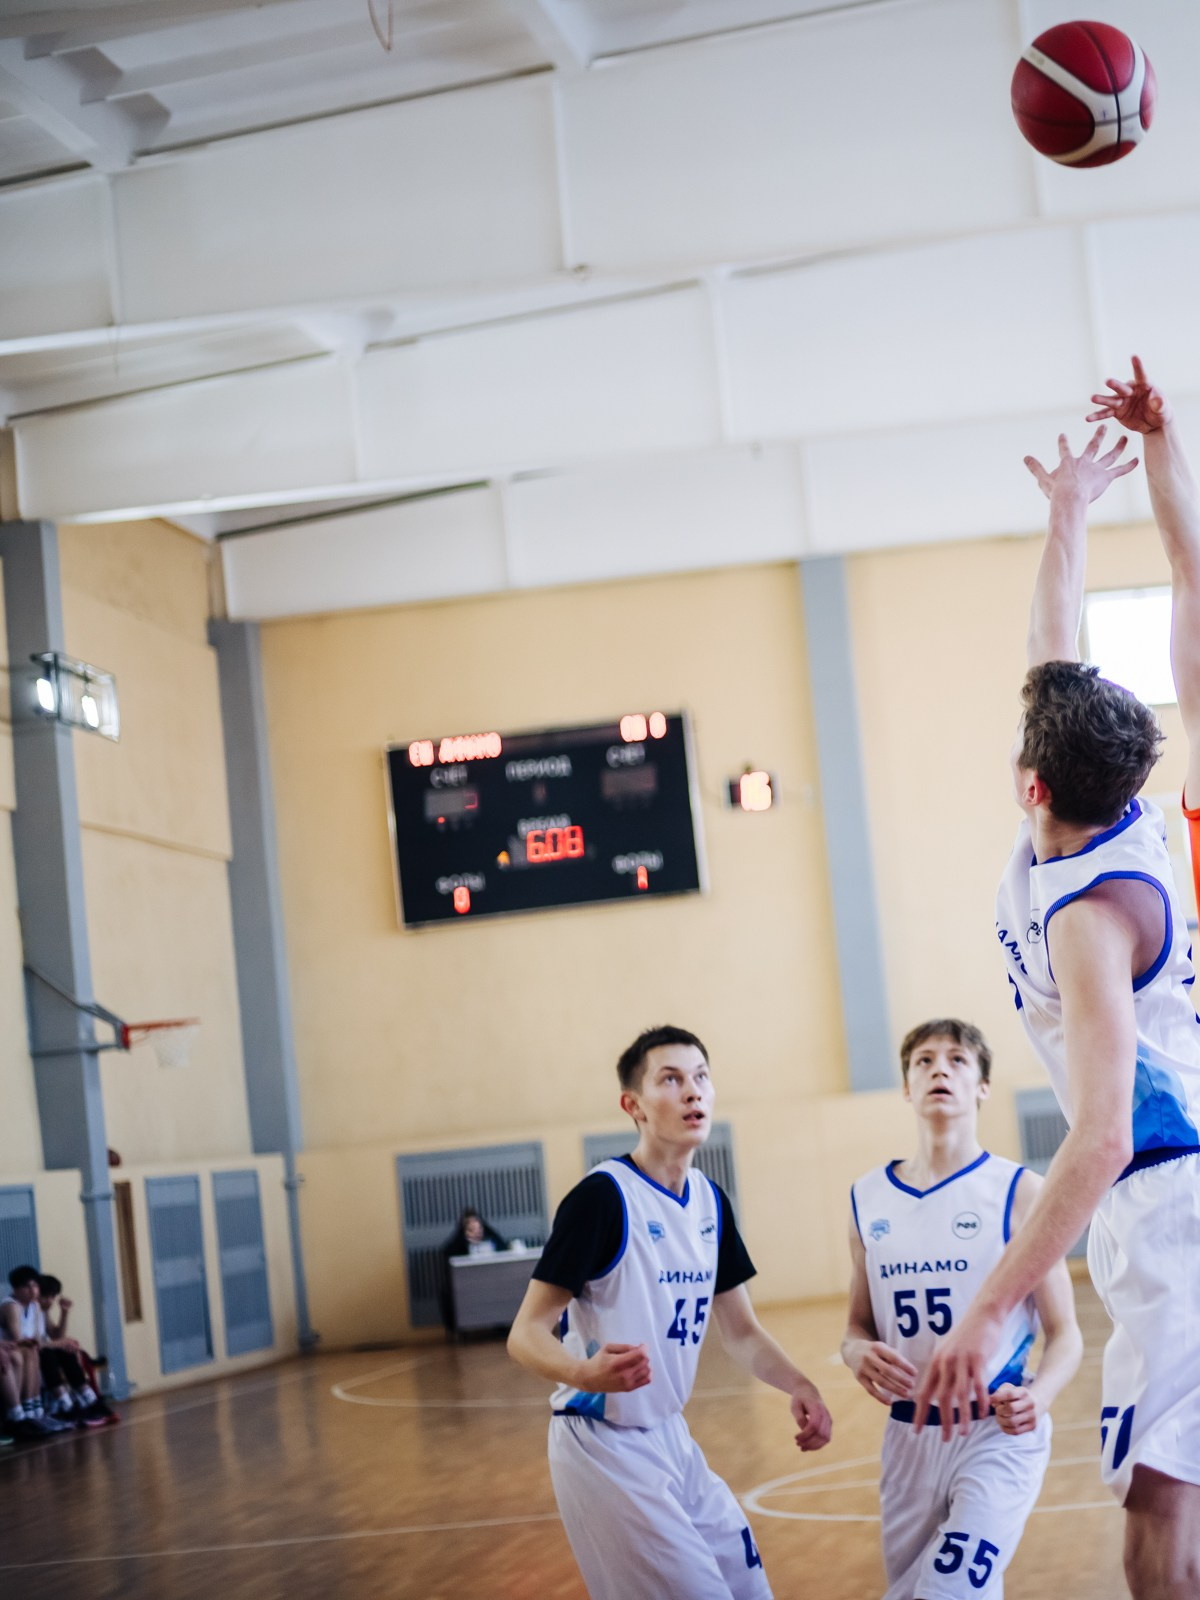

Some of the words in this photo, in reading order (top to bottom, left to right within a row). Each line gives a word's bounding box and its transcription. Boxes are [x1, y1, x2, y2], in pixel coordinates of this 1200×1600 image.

[880, 1259, 968, 1279] ДИНАМО
[667, 1297, 709, 1346] 45
[894, 1288, 952, 1338] 55
[934, 1532, 1000, 1589] 55
